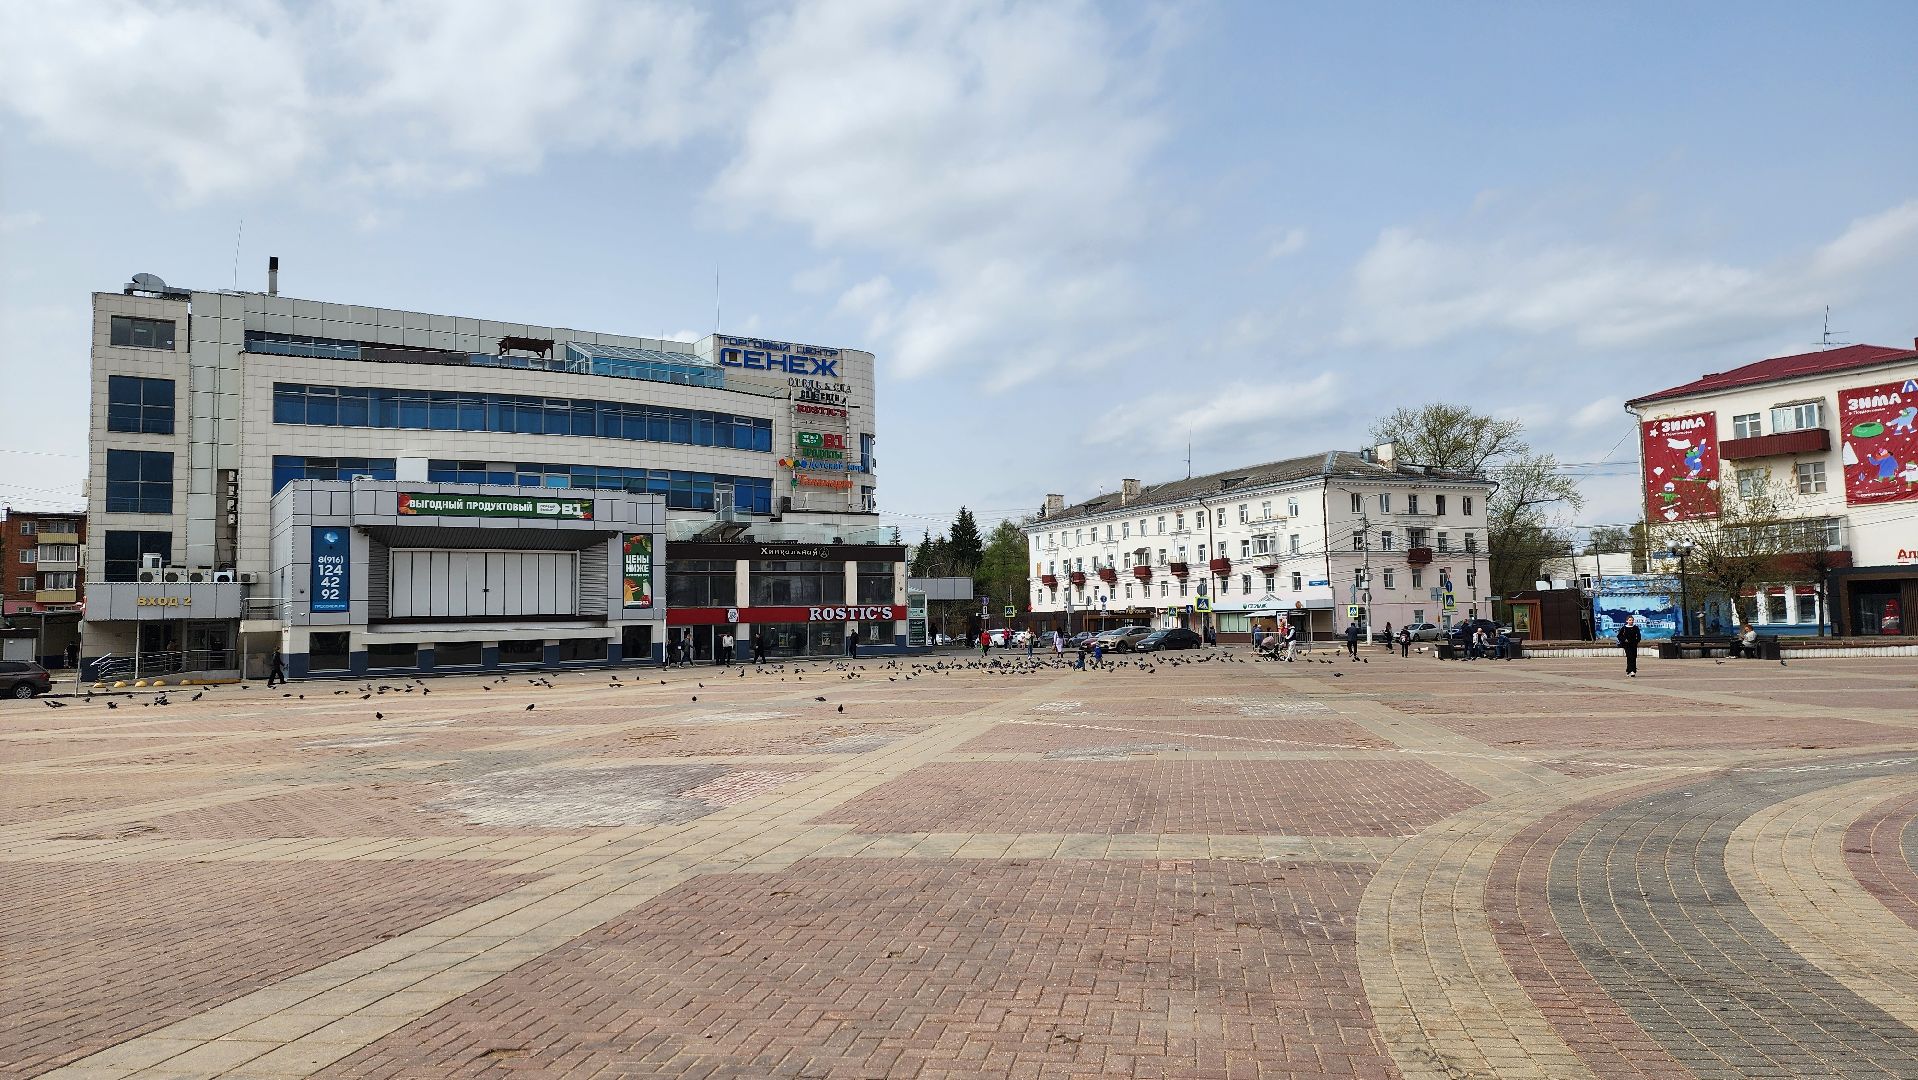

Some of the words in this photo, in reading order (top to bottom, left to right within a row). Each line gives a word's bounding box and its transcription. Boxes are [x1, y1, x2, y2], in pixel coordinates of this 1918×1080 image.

[720, 337, 791, 354] ТОРГОВЫЙ
[795, 345, 838, 357] ЦЕНТР
[719, 348, 839, 377] СЕНЕЖ
[1847, 392, 1901, 411] ЗИМА
[1661, 416, 1706, 432] ЗИМА
[409, 498, 463, 510] ВЫГОДНЫЙ
[466, 501, 533, 513] ПРОДУКТОВЫЙ
[318, 555, 344, 564] 8(916)
[625, 554, 649, 564] ЦЕНЫ
[318, 564, 343, 576] 124
[625, 563, 649, 573] НИЖЕ
[320, 576, 340, 588] 42
[321, 588, 340, 600] 92
[137, 596, 179, 608] ВХОД
[183, 596, 192, 607] 2
[809, 606, 893, 621] ROSTIC'S
